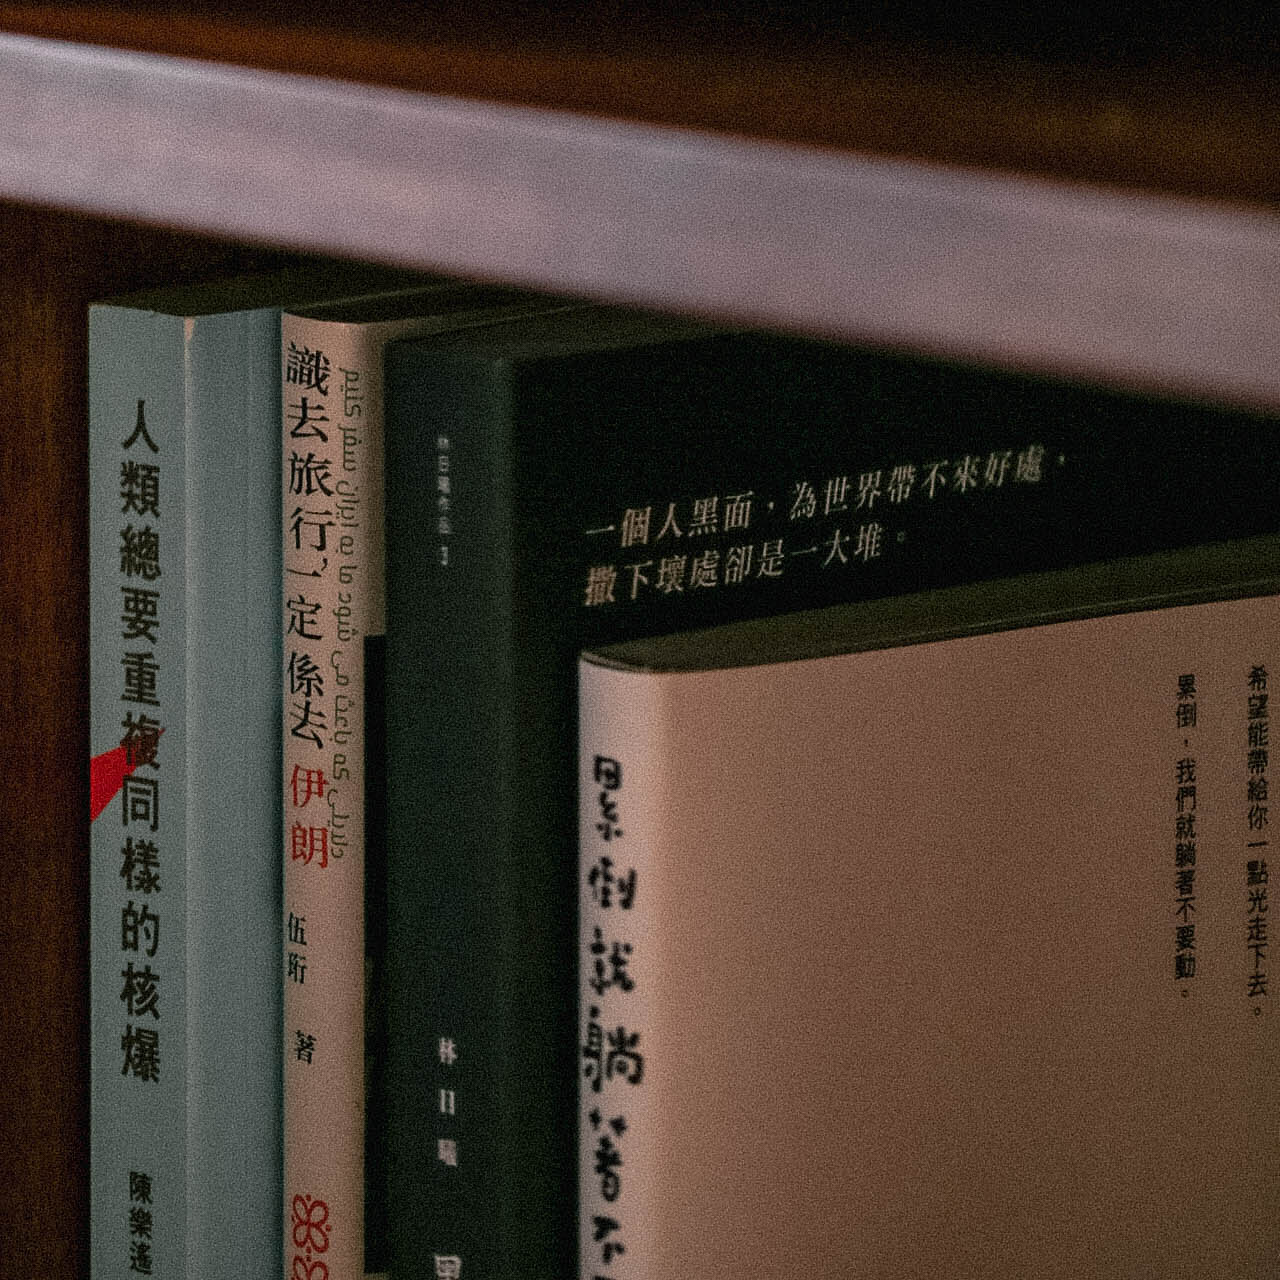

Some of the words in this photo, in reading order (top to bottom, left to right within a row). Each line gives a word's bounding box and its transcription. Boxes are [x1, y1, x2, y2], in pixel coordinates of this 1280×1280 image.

[338, 424, 362, 472] سفر
[335, 480, 360, 528] ایران
[336, 534, 355, 556] به
[339, 564, 359, 585] ما
[330, 694, 356, 745] باعث
